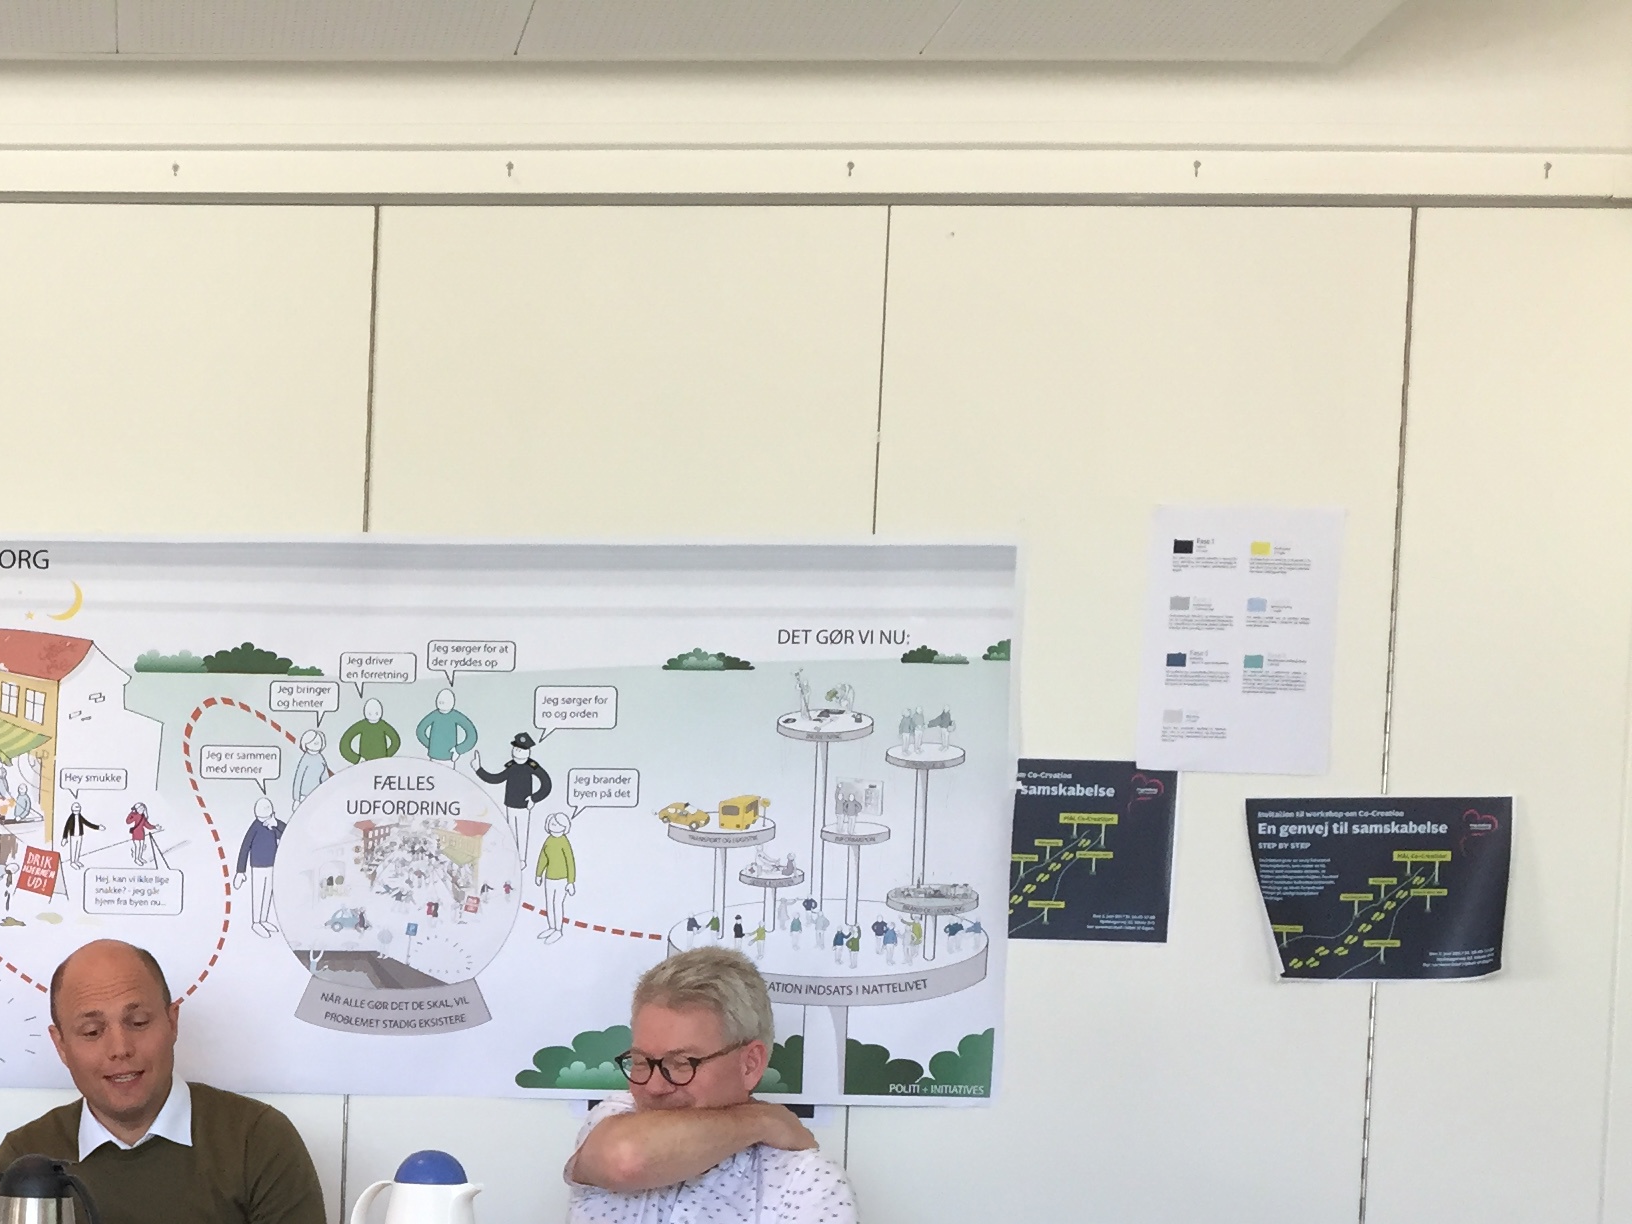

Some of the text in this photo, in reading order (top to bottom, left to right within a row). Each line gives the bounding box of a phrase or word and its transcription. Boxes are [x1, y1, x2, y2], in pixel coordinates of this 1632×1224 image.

[778, 628, 910, 645] DET GØR VI NU:
[432, 644, 508, 654] Jeg sørger for at
[346, 656, 394, 668] Jeg driver
[432, 657, 498, 668] der ryddes op
[360, 670, 409, 682] forretning
[276, 685, 332, 696] Jeg bringer
[276, 698, 324, 710] og henter
[542, 696, 608, 706] Jeg sørger for
[554, 710, 567, 720] og
[569, 710, 598, 718] orden
[206, 750, 277, 762] Jeg er sammen
[206, 764, 262, 774] med venner
[64, 772, 122, 784] Hey smukke
[374, 776, 436, 791] FÆLLES
[573, 776, 632, 786] Jeg brander
[573, 788, 630, 800] byen på det
[1020, 782, 1116, 798] samskabelse
[346, 800, 460, 816] UDFORDRING
[1257, 820, 1448, 838] En genvej til samskabelse
[1258, 842, 1312, 850] STEP BY STEP
[26, 852, 52, 869] DRIK
[26, 876, 48, 892] UD!
[95, 874, 170, 886] Hej, kan vi ikke lige
[805, 982, 852, 996] INDSATS
[862, 978, 928, 994] NATTELIVET
[320, 992, 470, 1011] NÅR ALLE GØR DET DE SKAL, VIL
[324, 1011, 466, 1029] PROBLEMET STADIG EKSISTERE
[888, 1084, 920, 1094] POLITI
[930, 1084, 984, 1095] INITIATIVES
